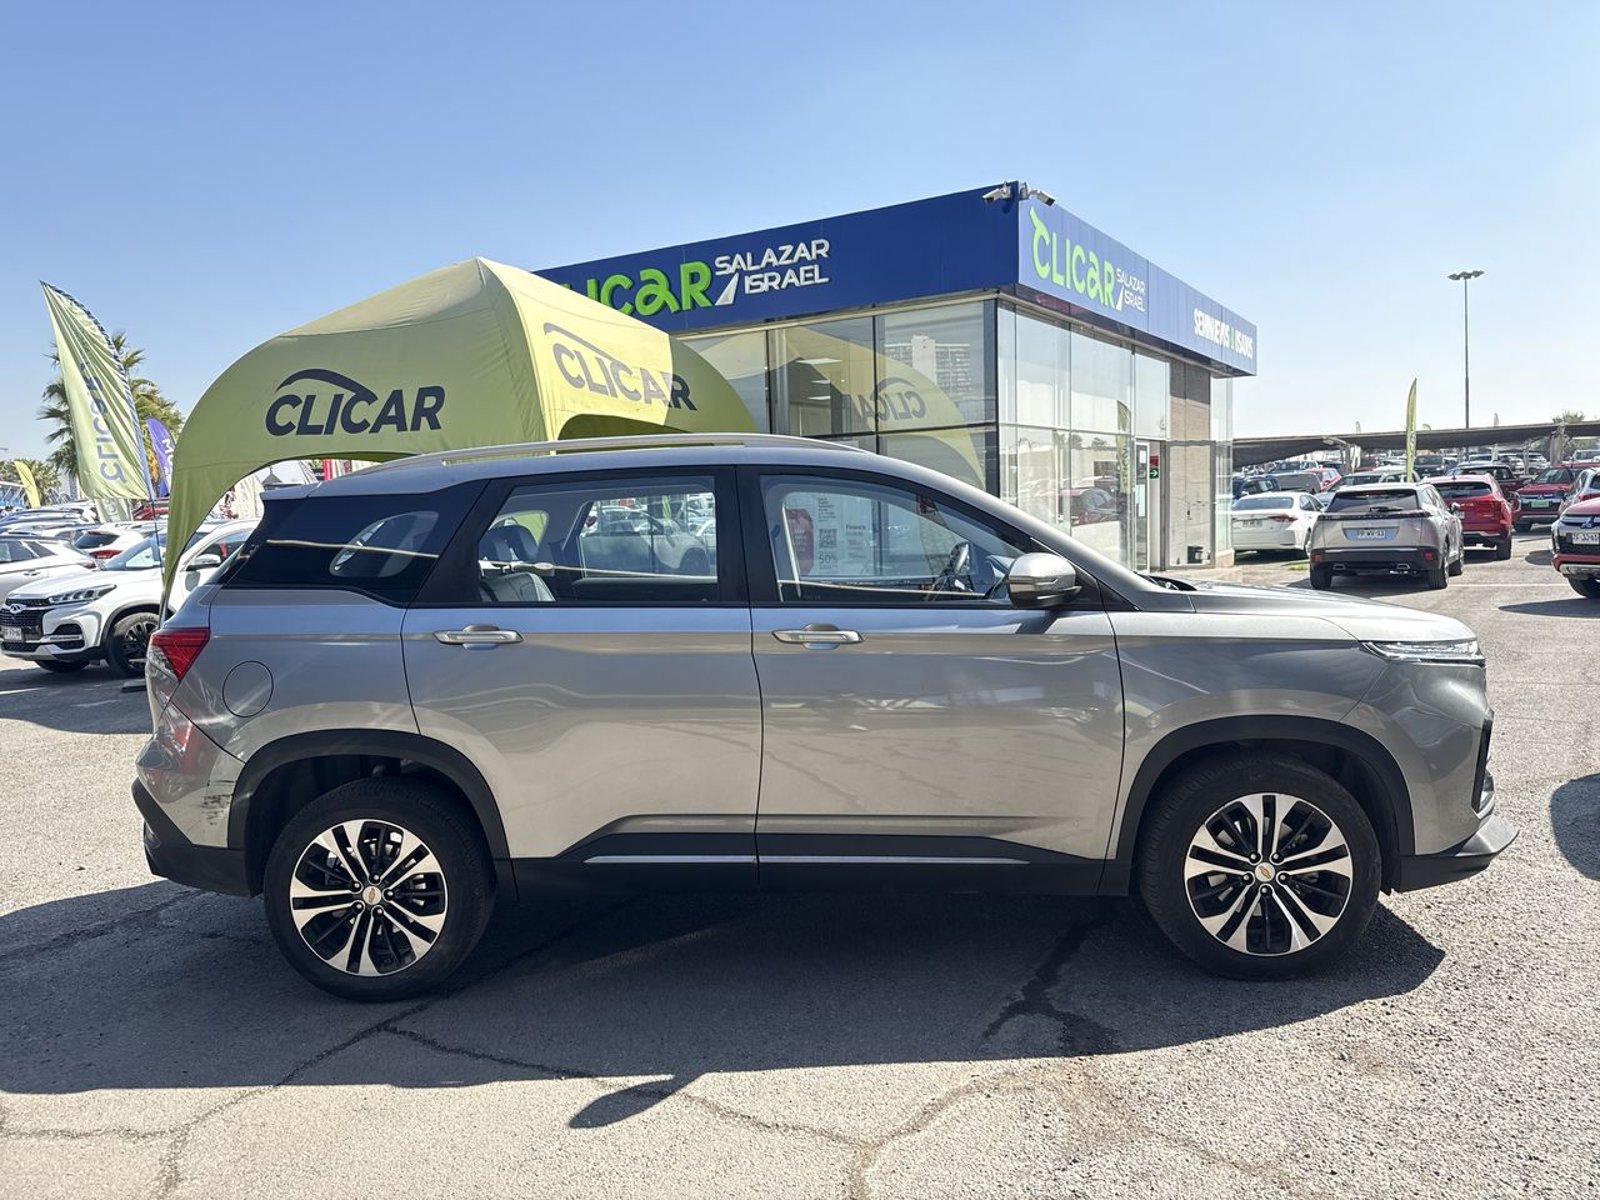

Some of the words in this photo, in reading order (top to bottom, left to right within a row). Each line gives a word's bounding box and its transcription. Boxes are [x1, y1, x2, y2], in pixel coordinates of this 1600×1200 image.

[715, 239, 830, 276] SALAZAR
[745, 264, 829, 295] ISRAEL
[553, 342, 698, 411] CLICAR
[265, 385, 446, 437] CLICAR
